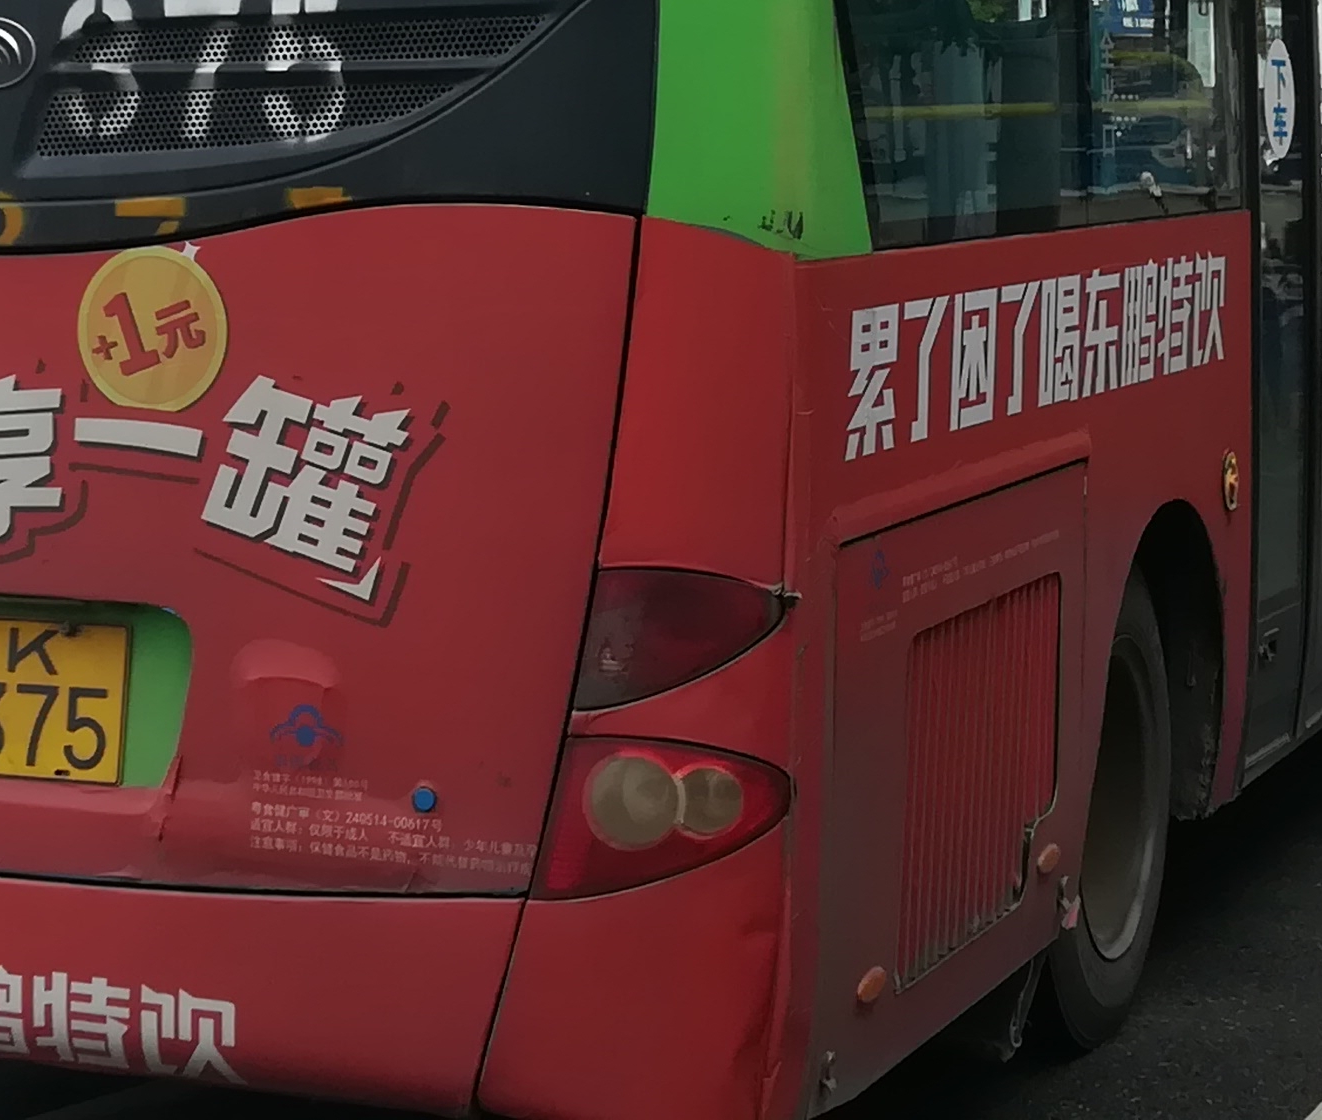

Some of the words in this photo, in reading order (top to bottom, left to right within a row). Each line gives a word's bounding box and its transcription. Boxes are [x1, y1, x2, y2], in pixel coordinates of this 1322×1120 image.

[1271, 59, 1288, 146] 下车
[91, 291, 206, 378] +1元
[845, 251, 1227, 461] 累了困了喝东鹏特饮
